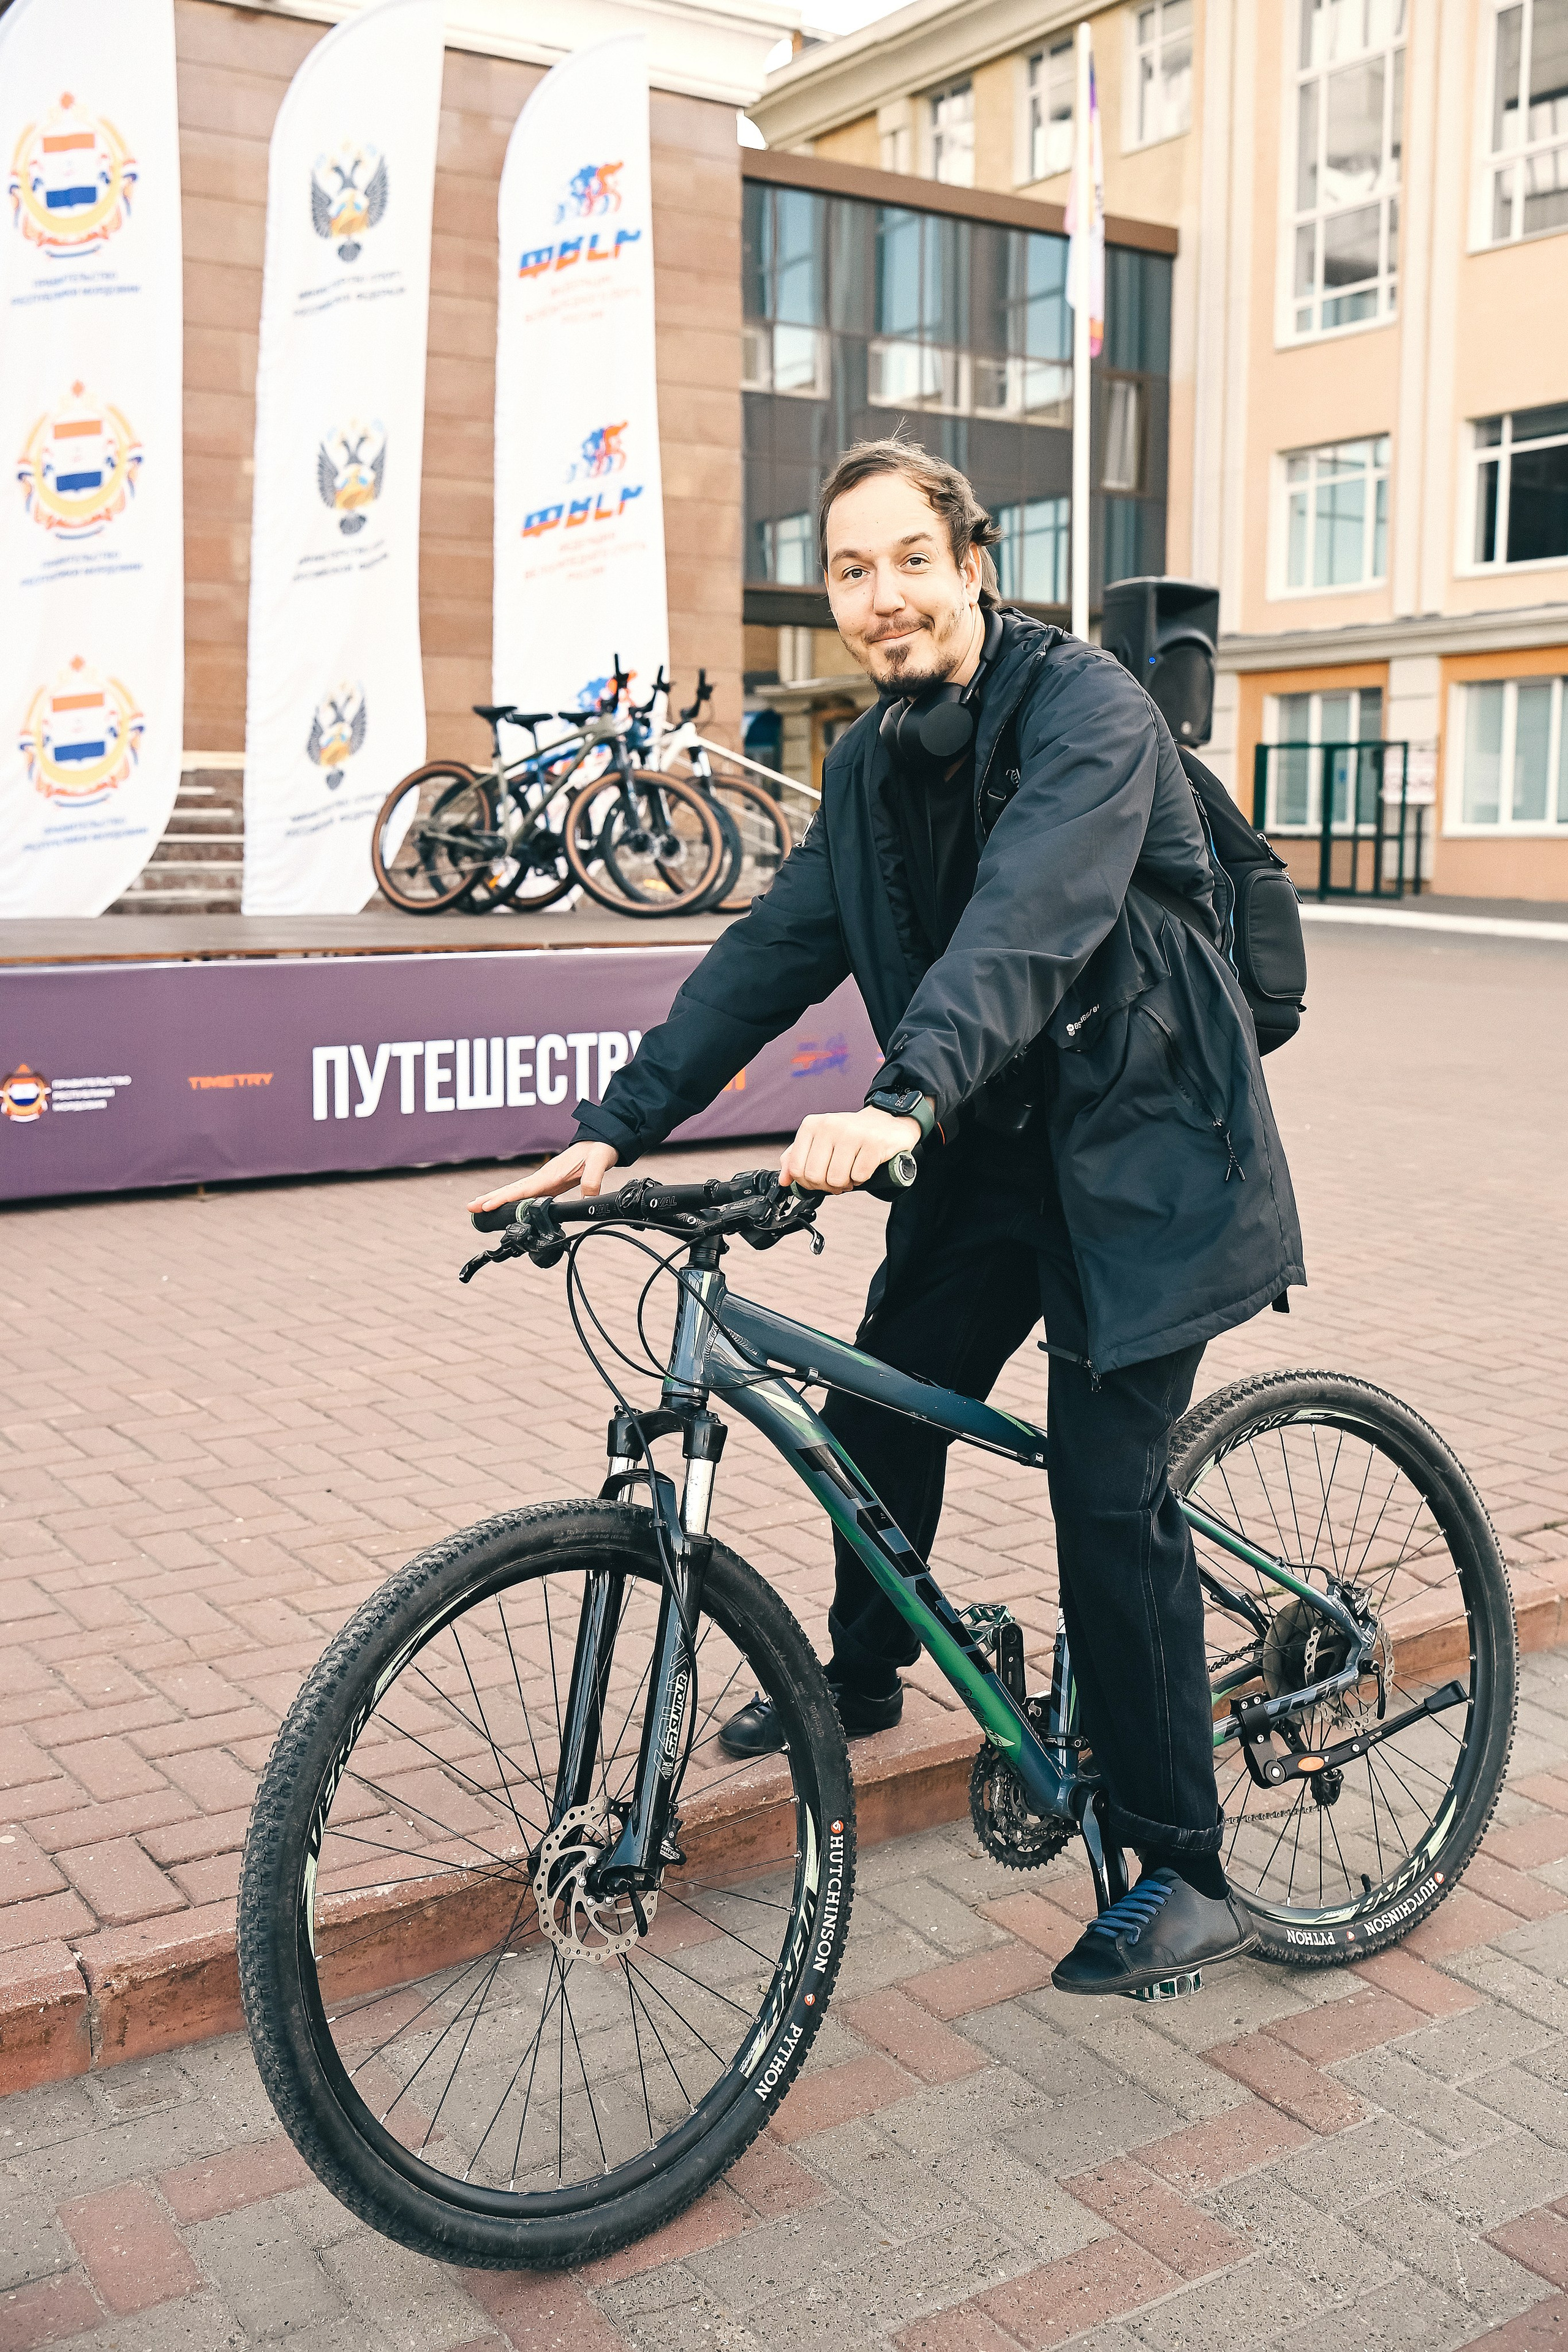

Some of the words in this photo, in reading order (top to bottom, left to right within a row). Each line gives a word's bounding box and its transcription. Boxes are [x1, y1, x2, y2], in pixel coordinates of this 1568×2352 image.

[312, 1030, 644, 1121] ПУТЕШЕСТВ
[588, 1204, 611, 1215] OVAL
[649, 1196, 677, 1208] OVAL
[795, 1443, 994, 1676] FUJI
[670, 1674, 688, 1732] SUNTOUR
[665, 1731, 678, 1755] SR
[660, 1844, 680, 1860] HAYES
[813, 1834, 844, 1973] HUTCHINSON
[1363, 1877, 1439, 1936] HUTCHINSON
[1286, 1929, 1336, 1946] PYTHON
[754, 2021, 804, 2101] PYTHON
